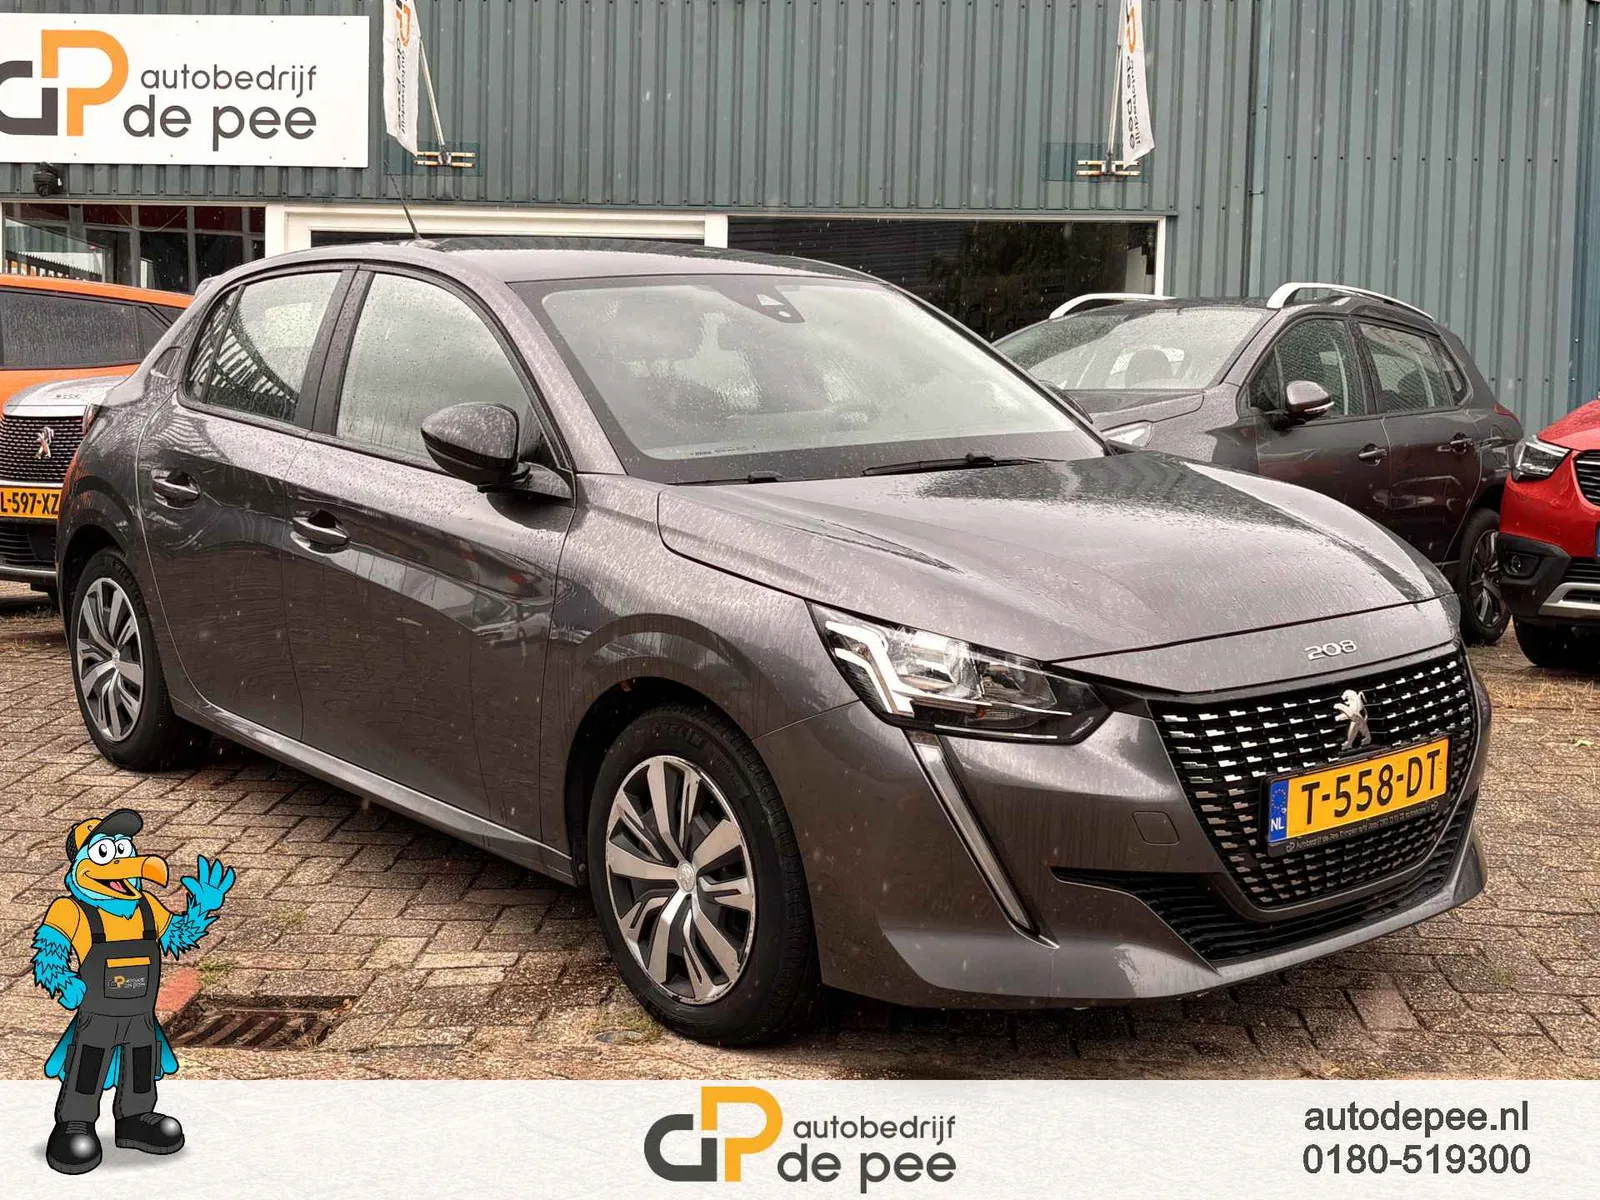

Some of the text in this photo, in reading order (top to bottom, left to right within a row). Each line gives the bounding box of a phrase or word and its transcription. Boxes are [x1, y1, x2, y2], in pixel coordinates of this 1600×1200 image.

[140, 63, 317, 98] autobedrijf
[123, 95, 317, 152] de pee
[1304, 639, 1357, 660] 208
[1301, 749, 1440, 825] T-558-DT
[1270, 817, 1285, 832] NL
